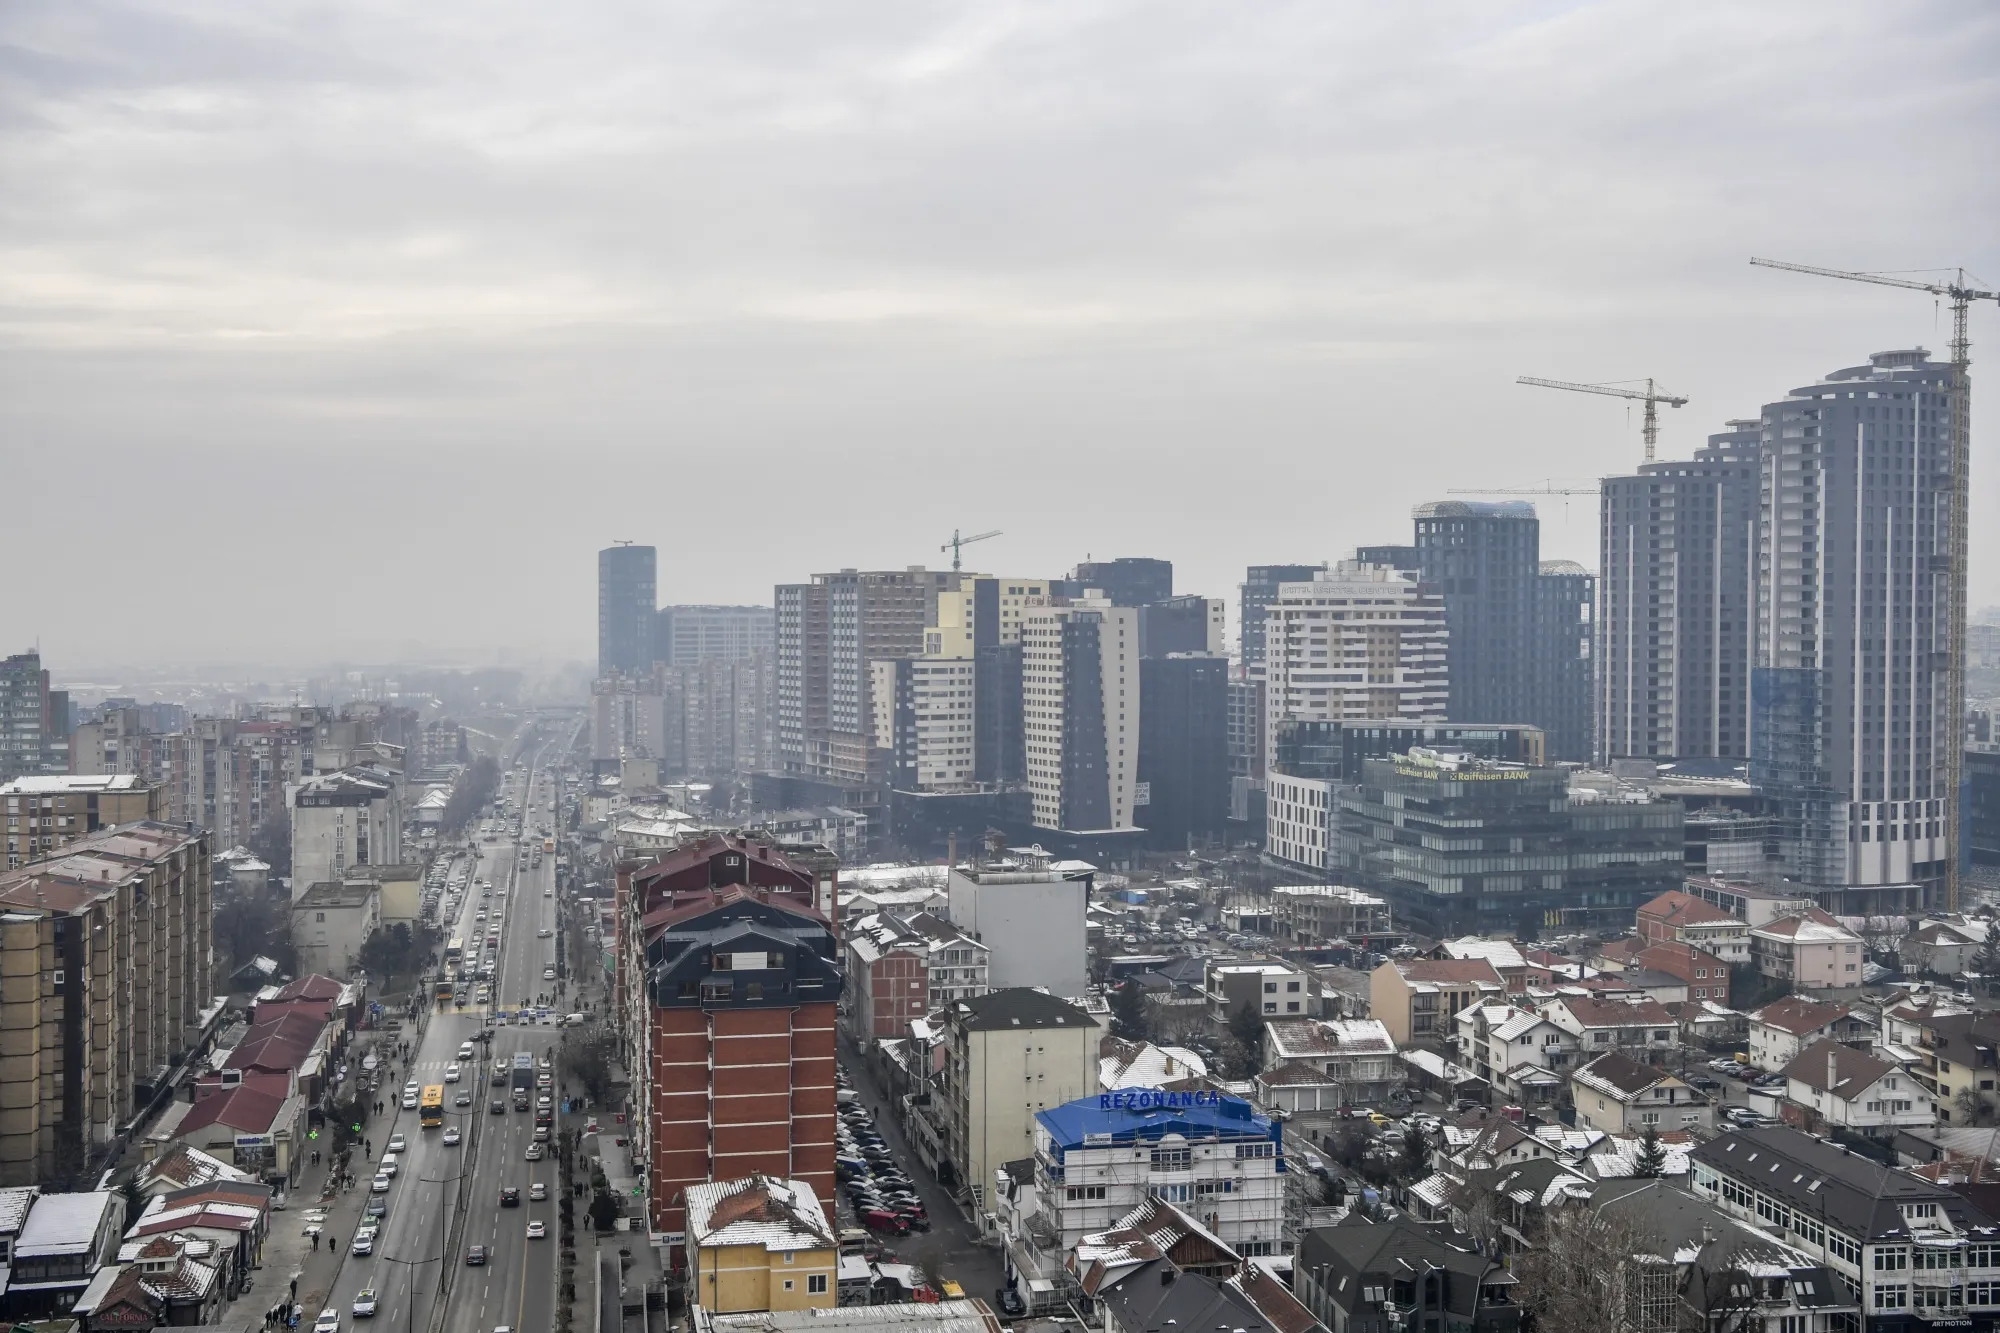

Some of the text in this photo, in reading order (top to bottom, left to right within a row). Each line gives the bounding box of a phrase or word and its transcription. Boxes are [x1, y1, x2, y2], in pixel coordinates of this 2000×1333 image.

[1423, 770, 1439, 780] BANK
[1458, 771, 1529, 780] Raiffeisen BANK
[1100, 1090, 1218, 1109] REZONANCA
[100, 1312, 148, 1321] CALIFORNIA
